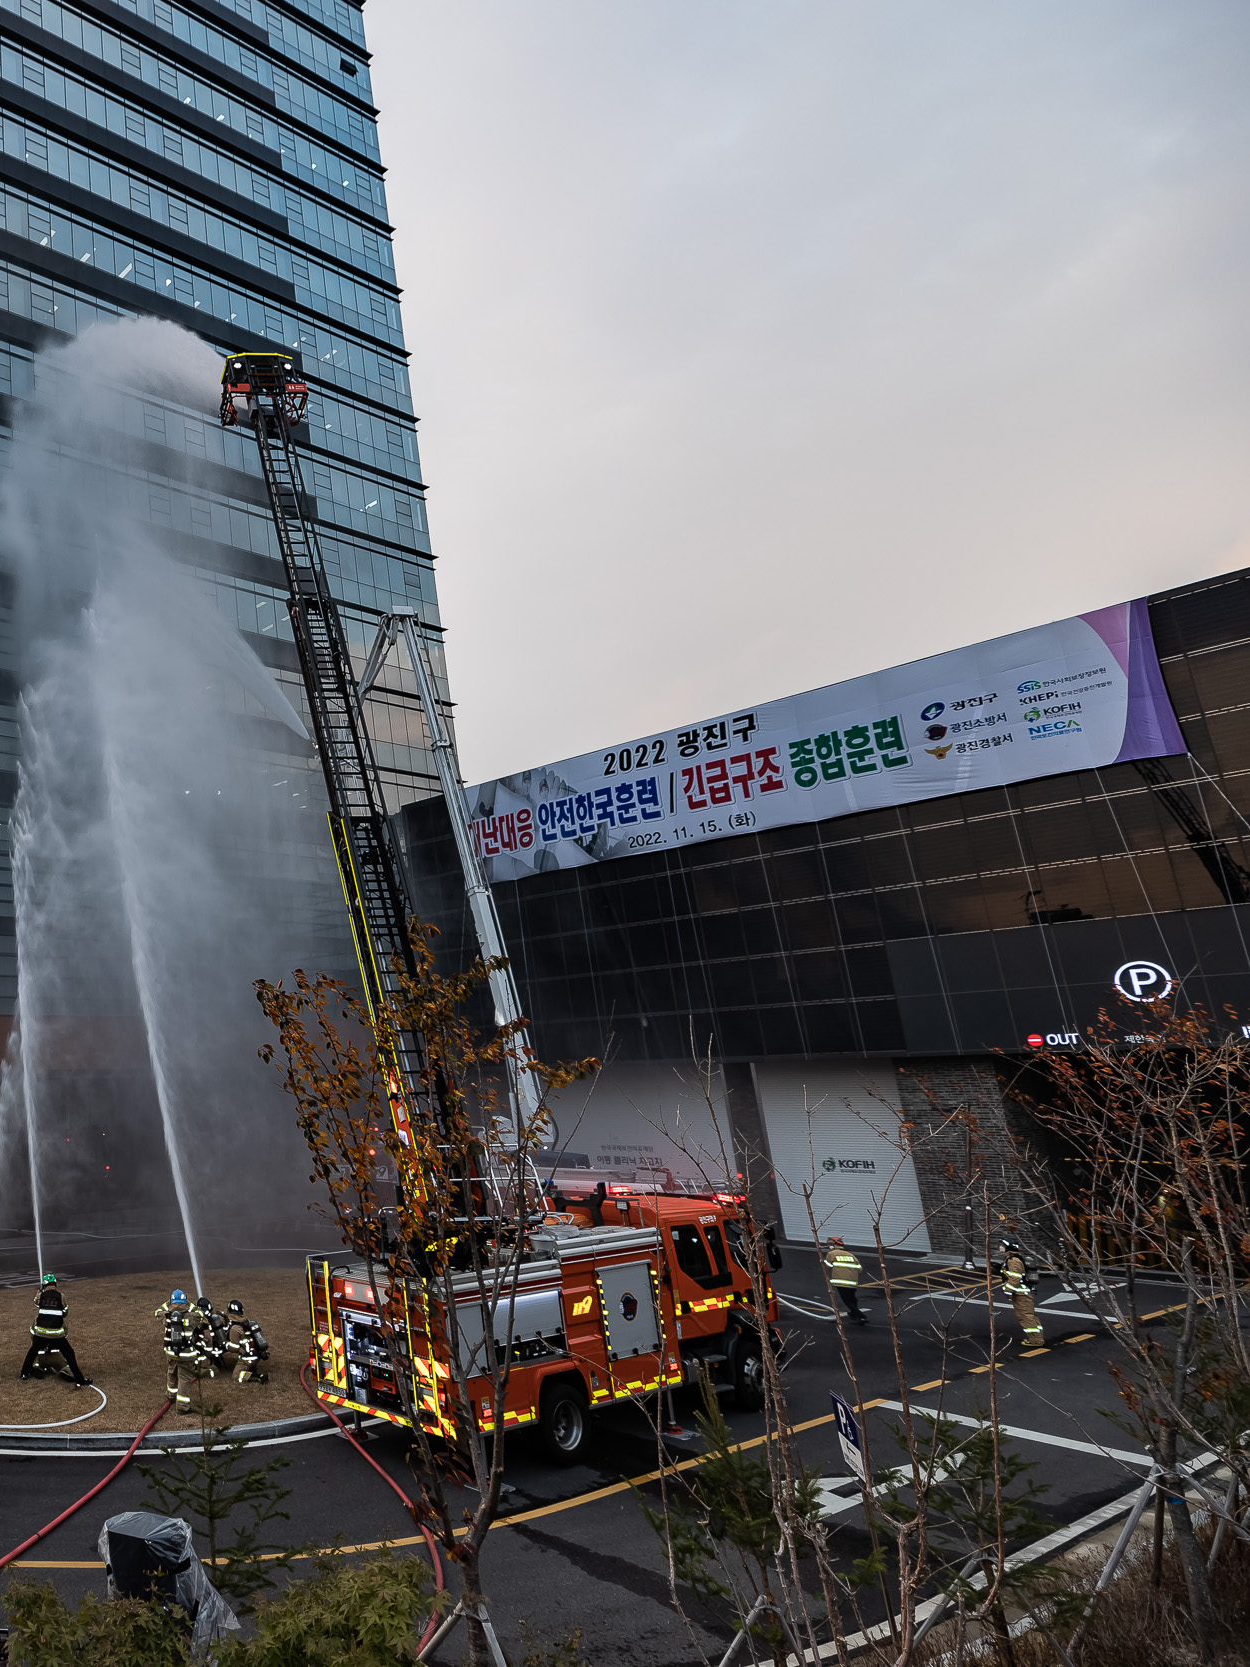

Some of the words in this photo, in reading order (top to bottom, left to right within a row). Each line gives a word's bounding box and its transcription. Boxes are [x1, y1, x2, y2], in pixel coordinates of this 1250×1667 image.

[950, 692, 998, 711] 광진구
[1043, 702, 1082, 715] KOFIH
[950, 712, 1008, 733] 광진소방서
[1028, 719, 1081, 735] NECA
[603, 739, 667, 776] 2022
[677, 713, 757, 758] 광진구
[955, 733, 1014, 754] 광진경찰서
[538, 775, 662, 842] 안전한국훈련
[681, 746, 785, 810] 긴급구조
[788, 715, 910, 788] 종합훈련
[627, 830, 667, 848] 2022.
[673, 827, 694, 841] 11.
[699, 821, 723, 835] 15.
[728, 810, 757, 830] (화)
[1129, 968, 1158, 996] P
[1046, 1032, 1080, 1046] OUT
[596, 1155, 612, 1165] 이동
[838, 1159, 875, 1169] KOFIH
[572, 1295, 593, 1316] 119
[837, 1402, 847, 1434] P
